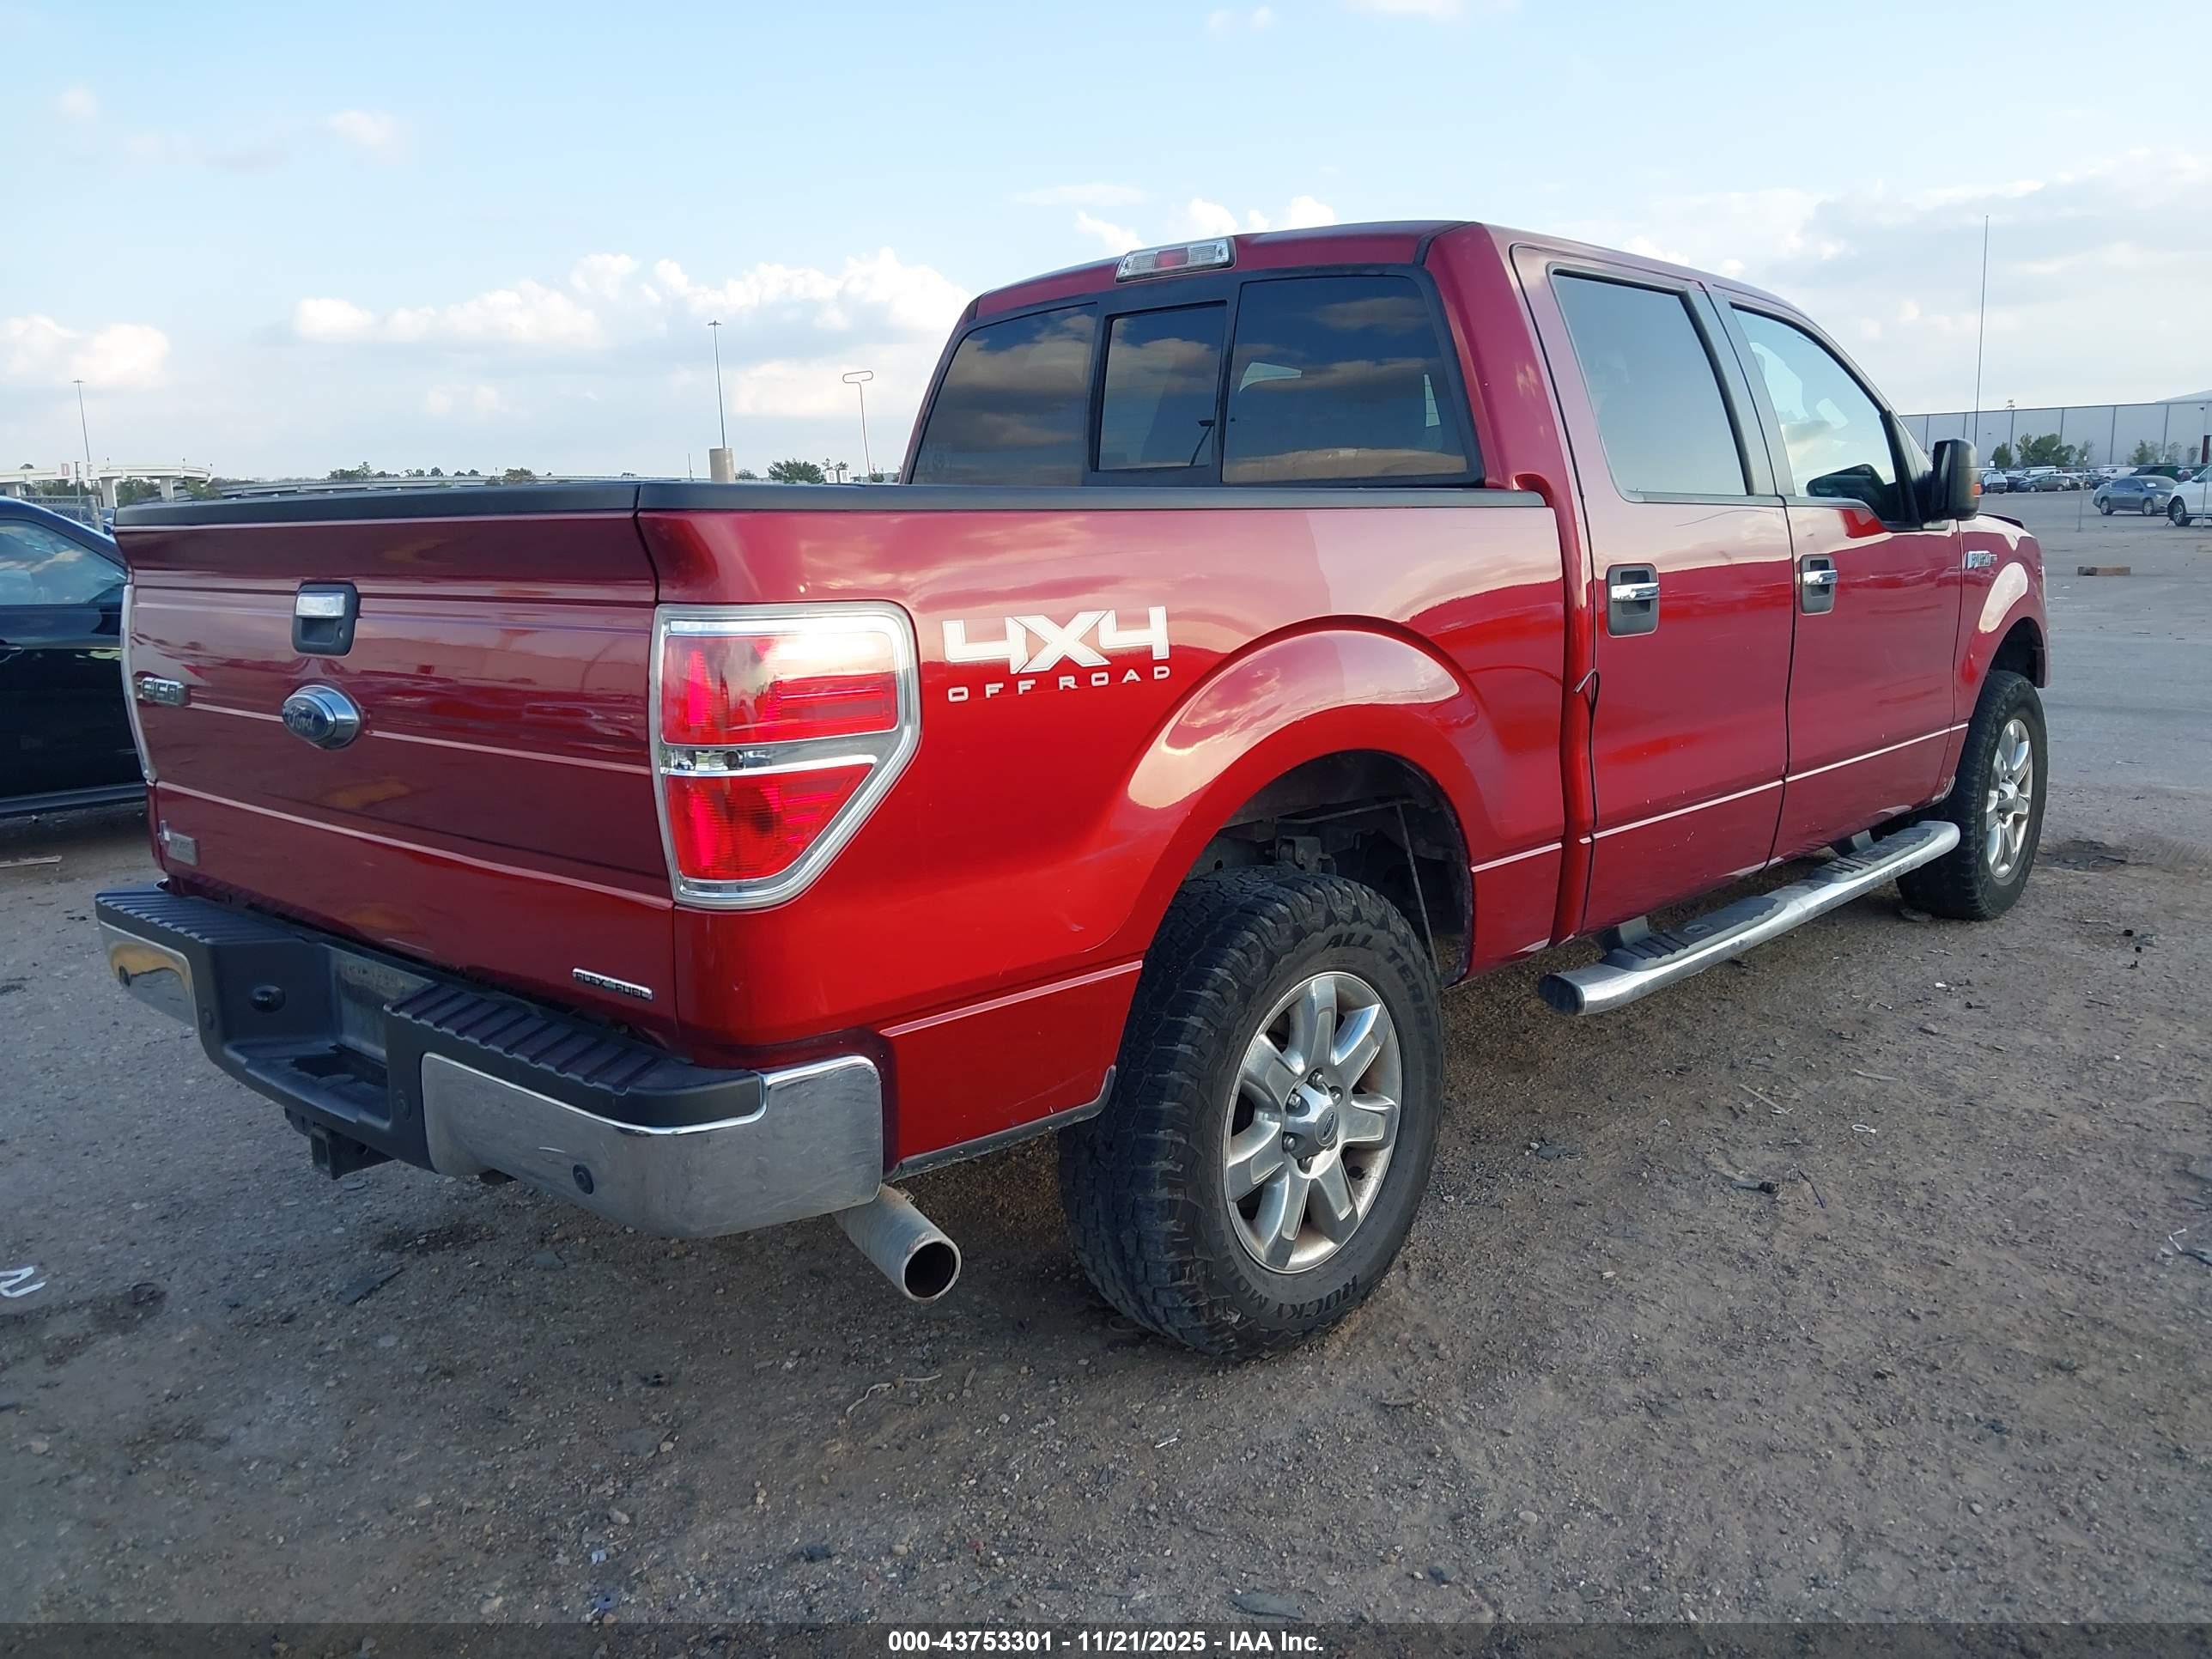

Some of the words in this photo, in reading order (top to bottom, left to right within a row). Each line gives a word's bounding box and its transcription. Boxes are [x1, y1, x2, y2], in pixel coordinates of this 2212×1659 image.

[947, 679, 1036, 702] OFF
[1059, 665, 1170, 691] ROAD
[1329, 932, 1373, 951] ALL
[573, 970, 606, 988] FLEX
[614, 983, 652, 1000] FUEL
